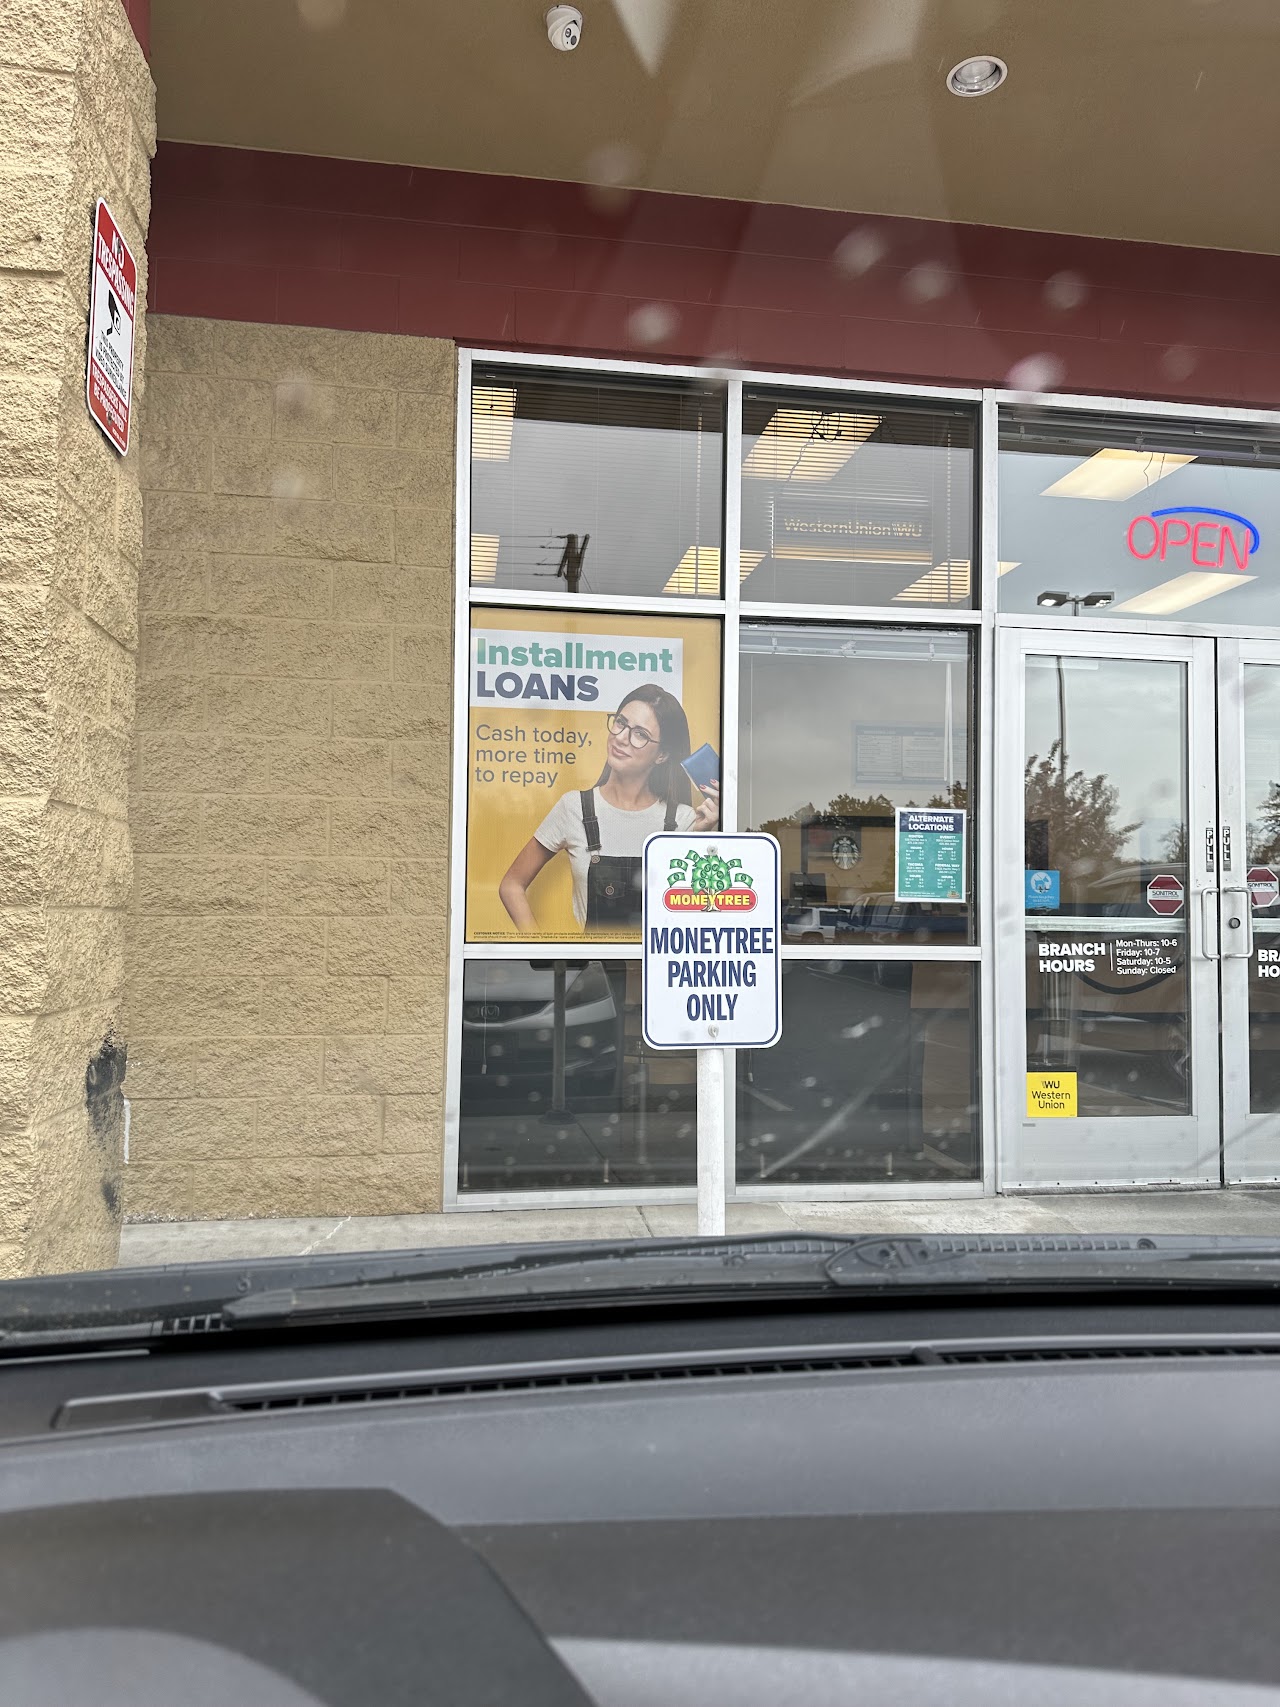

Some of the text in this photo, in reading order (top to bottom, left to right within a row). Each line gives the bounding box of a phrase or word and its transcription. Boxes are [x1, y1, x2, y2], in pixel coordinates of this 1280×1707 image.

[112, 230, 124, 269] NO
[98, 232, 134, 318] TRESPASSING
[1127, 515, 1250, 570] OPEN
[477, 638, 673, 672] Installment
[477, 670, 599, 701] LOANS
[476, 724, 592, 747] Cash today,
[476, 748, 576, 764] more time
[475, 767, 558, 788] to repay
[908, 815, 954, 823] ALTERNATE
[908, 823, 954, 831] LOCATIONS
[670, 894, 750, 906] MONEYTREE
[651, 927, 774, 954] MONEYTREE
[1115, 939, 1177, 947] Mon-Thurs: 10-6
[1038, 942, 1106, 956] BRANCH
[1116, 948, 1160, 958] Friday: 10-7
[1258, 949, 1280, 962] BR
[1039, 959, 1096, 973] HOURS
[1116, 957, 1171, 967] Saturday: 10-5
[668, 960, 756, 988] PARKING
[1117, 966, 1176, 976] Sunday: Closed
[687, 994, 738, 1021] ONLY
[1043, 1081, 1060, 1089] WU
[1032, 1091, 1071, 1100] Western
[1038, 1100, 1065, 1109] Union
